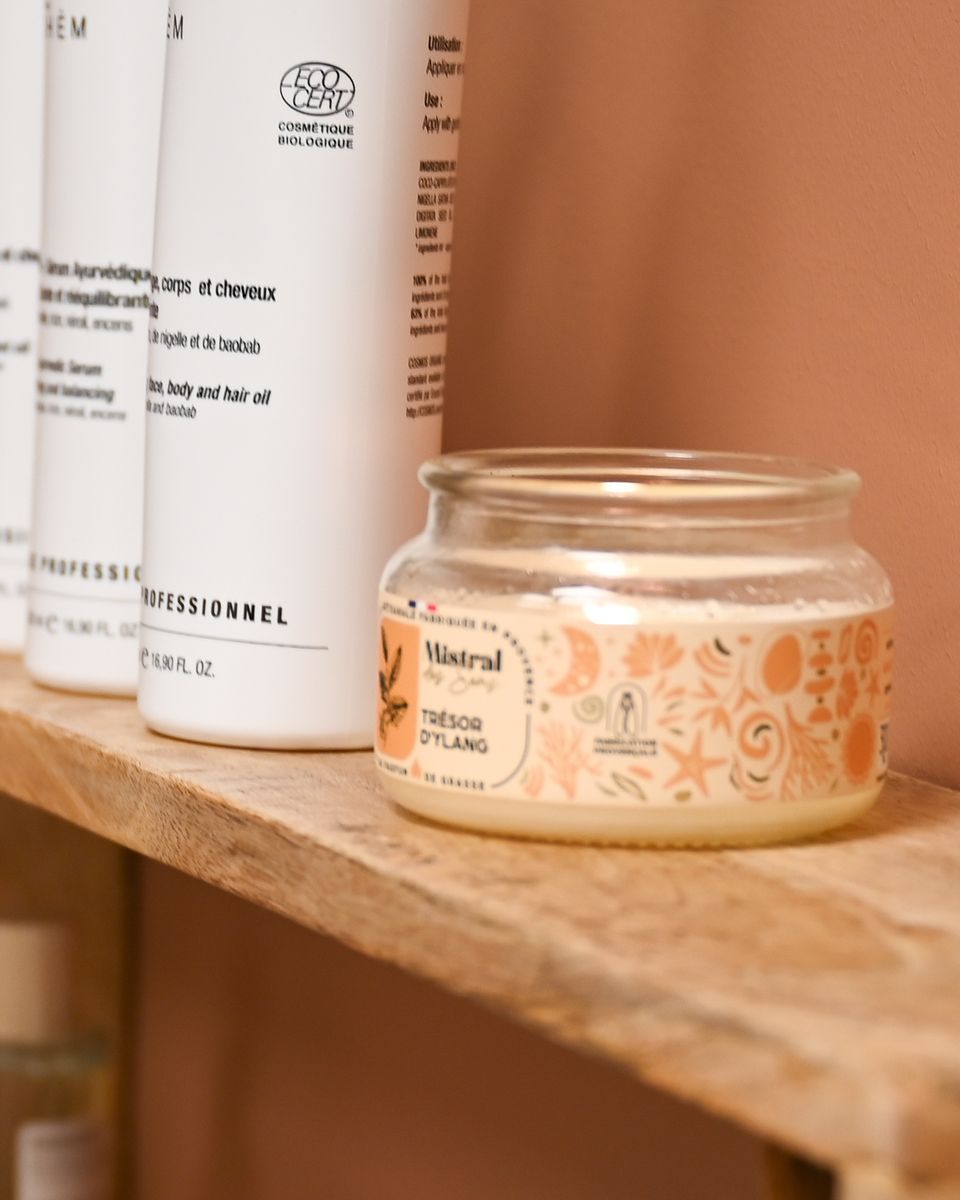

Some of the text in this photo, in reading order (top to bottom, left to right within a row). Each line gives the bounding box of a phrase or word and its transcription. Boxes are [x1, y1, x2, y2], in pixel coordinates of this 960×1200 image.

[294, 66, 340, 90] ECO
[293, 88, 349, 112] CERT
[424, 90, 439, 109] Use
[278, 121, 355, 136] COSMÉTIQUE
[278, 135, 354, 150] BIOLOGIQUE
[161, 276, 192, 298] corps
[199, 278, 212, 297] et
[215, 279, 277, 302] cheveux
[190, 333, 200, 350] et
[202, 333, 217, 351] de
[218, 335, 261, 356] baobab
[167, 378, 194, 401] body
[196, 383, 221, 401] and
[223, 384, 251, 404] hair
[252, 388, 272, 406] oil
[425, 639, 502, 672] Mistral
[422, 708, 483, 732] TRÉSOR
[420, 729, 489, 755] D'YLANG
